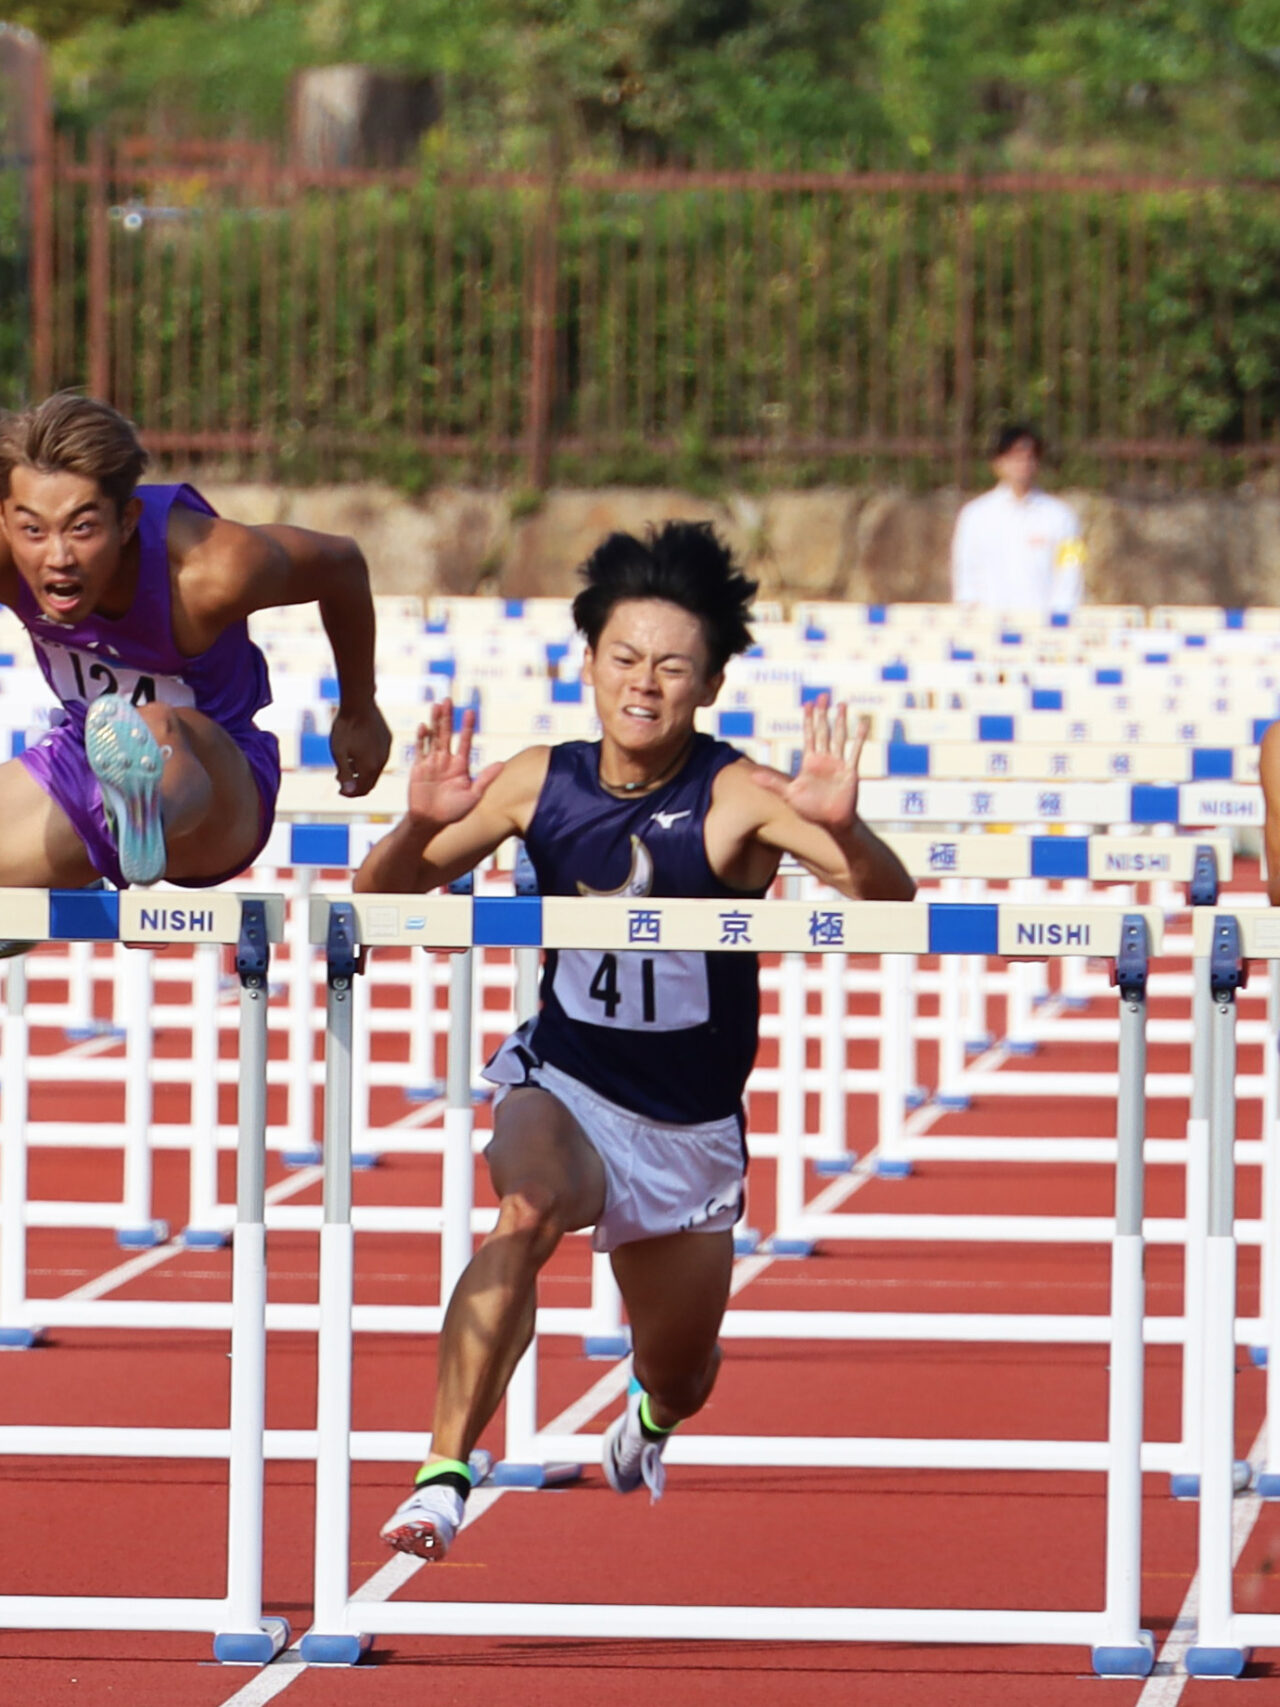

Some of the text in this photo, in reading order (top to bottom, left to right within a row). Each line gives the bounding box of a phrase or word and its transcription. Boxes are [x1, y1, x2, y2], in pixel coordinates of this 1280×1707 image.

[1107, 853, 1169, 872] NISHI
[140, 908, 214, 932] NISHI
[628, 909, 844, 946] 西京極
[1016, 922, 1091, 947] NISHI
[588, 953, 656, 1024] 41
